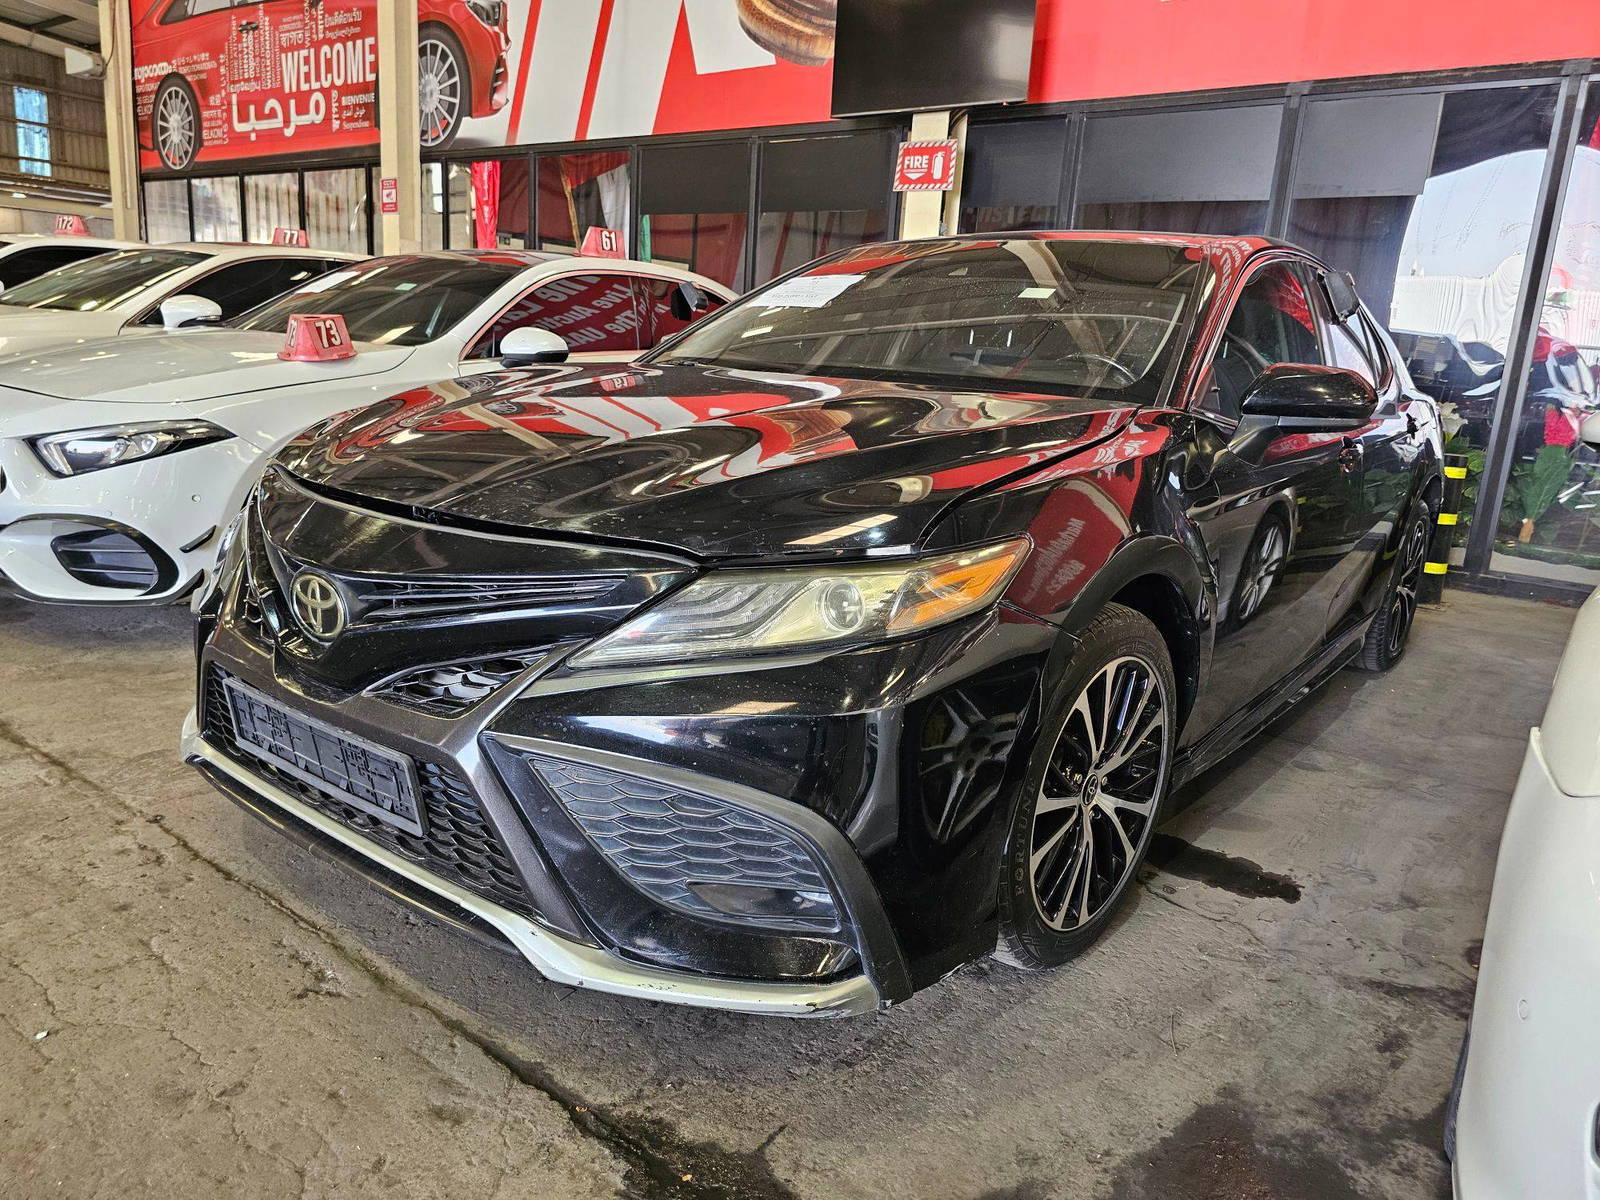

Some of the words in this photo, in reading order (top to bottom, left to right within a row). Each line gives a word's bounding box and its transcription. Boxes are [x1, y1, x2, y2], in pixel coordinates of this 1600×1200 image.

[281, 36, 376, 94] WELCOME
[232, 91, 326, 141] مرحبا
[903, 155, 929, 168] FIRE
[58, 215, 74, 231] 172
[284, 229, 299, 245] 77
[601, 230, 617, 252] 61
[315, 319, 342, 348] 73
[1014, 777, 1036, 897] FORTUNE
